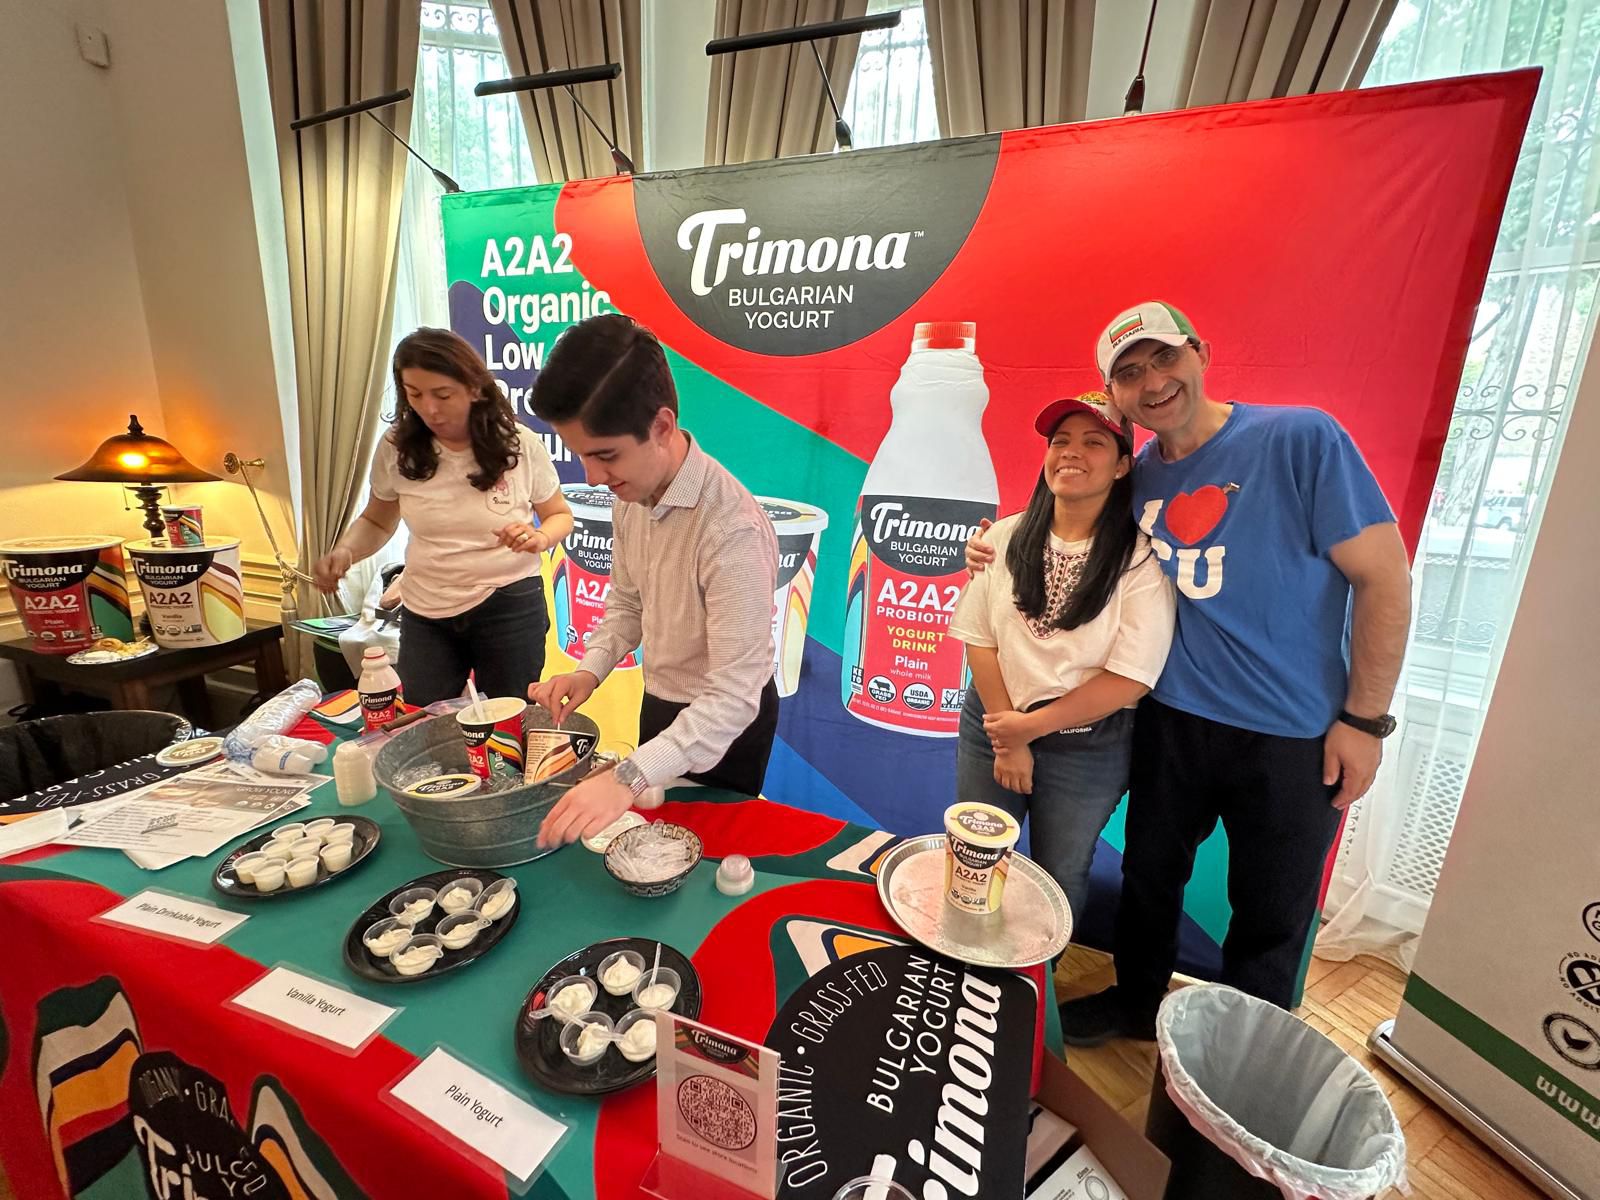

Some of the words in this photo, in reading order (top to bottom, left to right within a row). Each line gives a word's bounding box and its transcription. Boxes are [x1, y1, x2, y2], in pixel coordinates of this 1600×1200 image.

[481, 233, 573, 278] A2A2
[676, 208, 911, 296] Trimona
[728, 285, 854, 307] BULGARIAN
[483, 280, 611, 334] Organic
[745, 310, 834, 329] YOGURT
[485, 334, 544, 370] Low
[566, 521, 614, 550] Trimo
[578, 550, 613, 561] BULGARI
[891, 541, 957, 557] BULGARIAN
[2, 559, 83, 580] Trimona
[132, 557, 200, 576] Trimona
[585, 560, 612, 569] YOGUR
[899, 553, 948, 567] YOGURT
[19, 576, 66, 584] BULGARIAN
[149, 591, 192, 605] A2A2
[575, 578, 612, 602] A2A
[877, 578, 960, 612] A2A2
[24, 594, 79, 609] A2A2
[575, 597, 604, 608] PROBIOTIC
[877, 605, 952, 625] PROBIOTI
[887, 625, 945, 642] YOGURT
[893, 639, 936, 653] DRINK
[895, 655, 928, 670] Plain
[890, 668, 913, 678] whole
[915, 671, 932, 680] milk
[361, 695, 392, 705] Trimona
[871, 689, 892, 698] GRASS
[906, 697, 930, 705] ORGANIC
[910, 689, 929, 698] USDA
[368, 711, 391, 719] A2A2
[959, 815, 1003, 829] Trimona
[971, 824, 996, 833] A2A2
[951, 837, 998, 860] Trimona
[955, 866, 987, 882] A2A2
[136, 903, 158, 912] Plain
[193, 916, 222, 928] Yogurt
[286, 987, 315, 1005] Vanilla
[313, 999, 346, 1016] Yogurt
[791, 961, 888, 1043] GRASS-FED
[910, 963, 956, 1074] YOGURT
[691, 1029, 737, 1055] Trimona
[866, 955, 931, 1114] BULGARIAN
[864, 972, 1002, 1200] imona
[445, 1084, 471, 1106] Plain
[470, 1099, 504, 1128] Yogurt
[775, 1060, 828, 1188] ORGANIC
